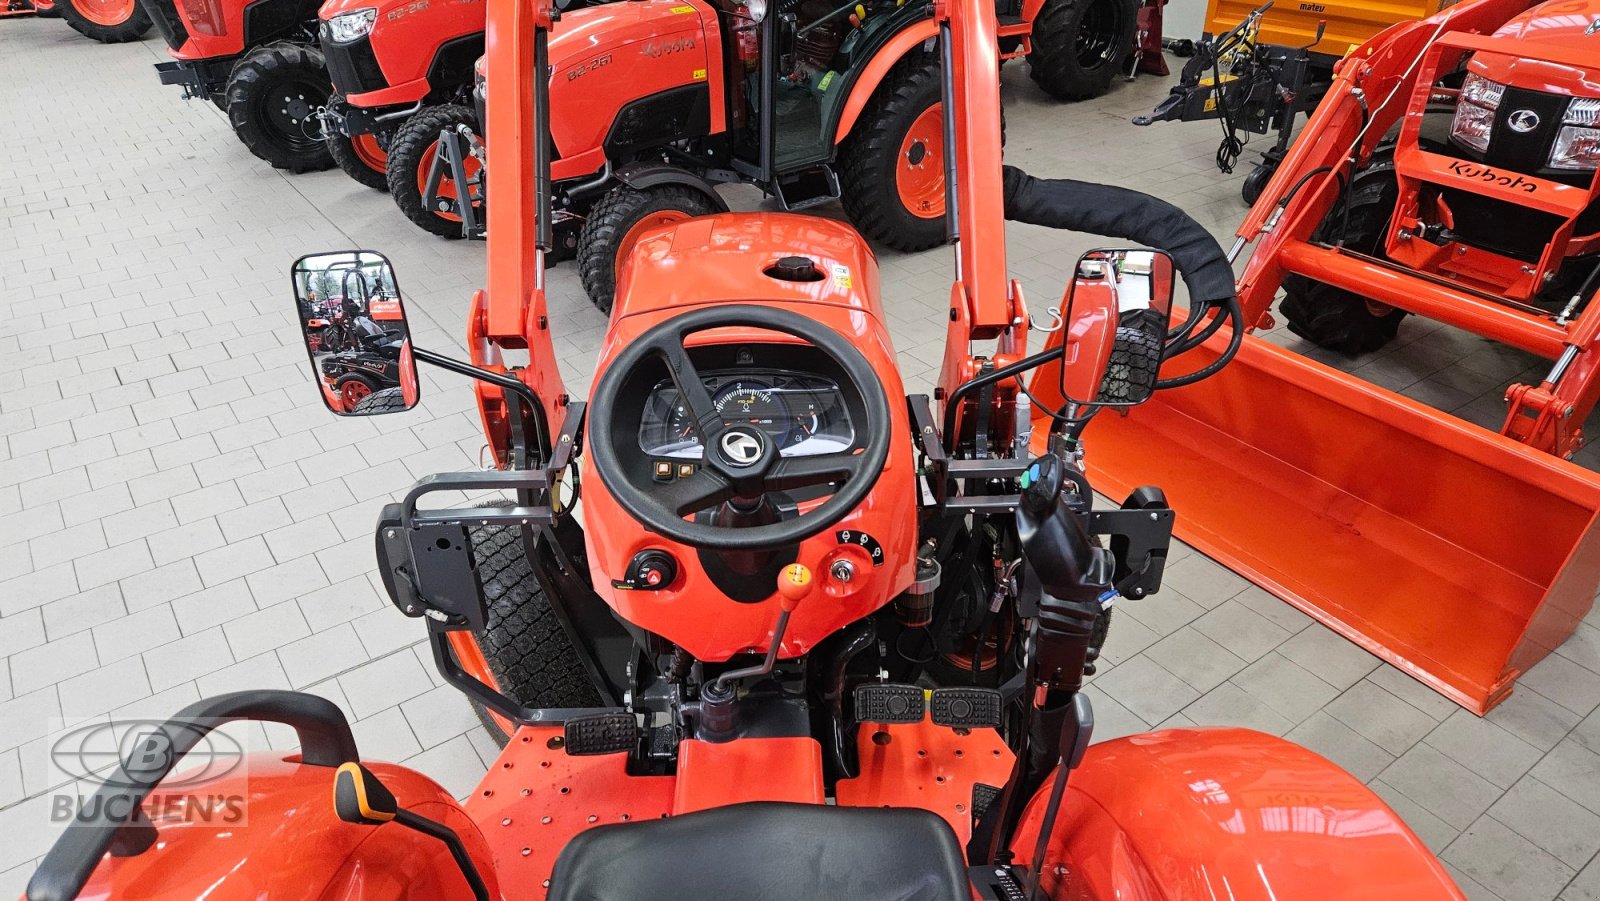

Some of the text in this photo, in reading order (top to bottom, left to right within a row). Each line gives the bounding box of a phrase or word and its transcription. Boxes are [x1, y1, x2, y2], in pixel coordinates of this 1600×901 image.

[641, 36, 696, 58] Kubota
[567, 54, 613, 82] B2-261
[1449, 161, 1537, 193] Kubota
